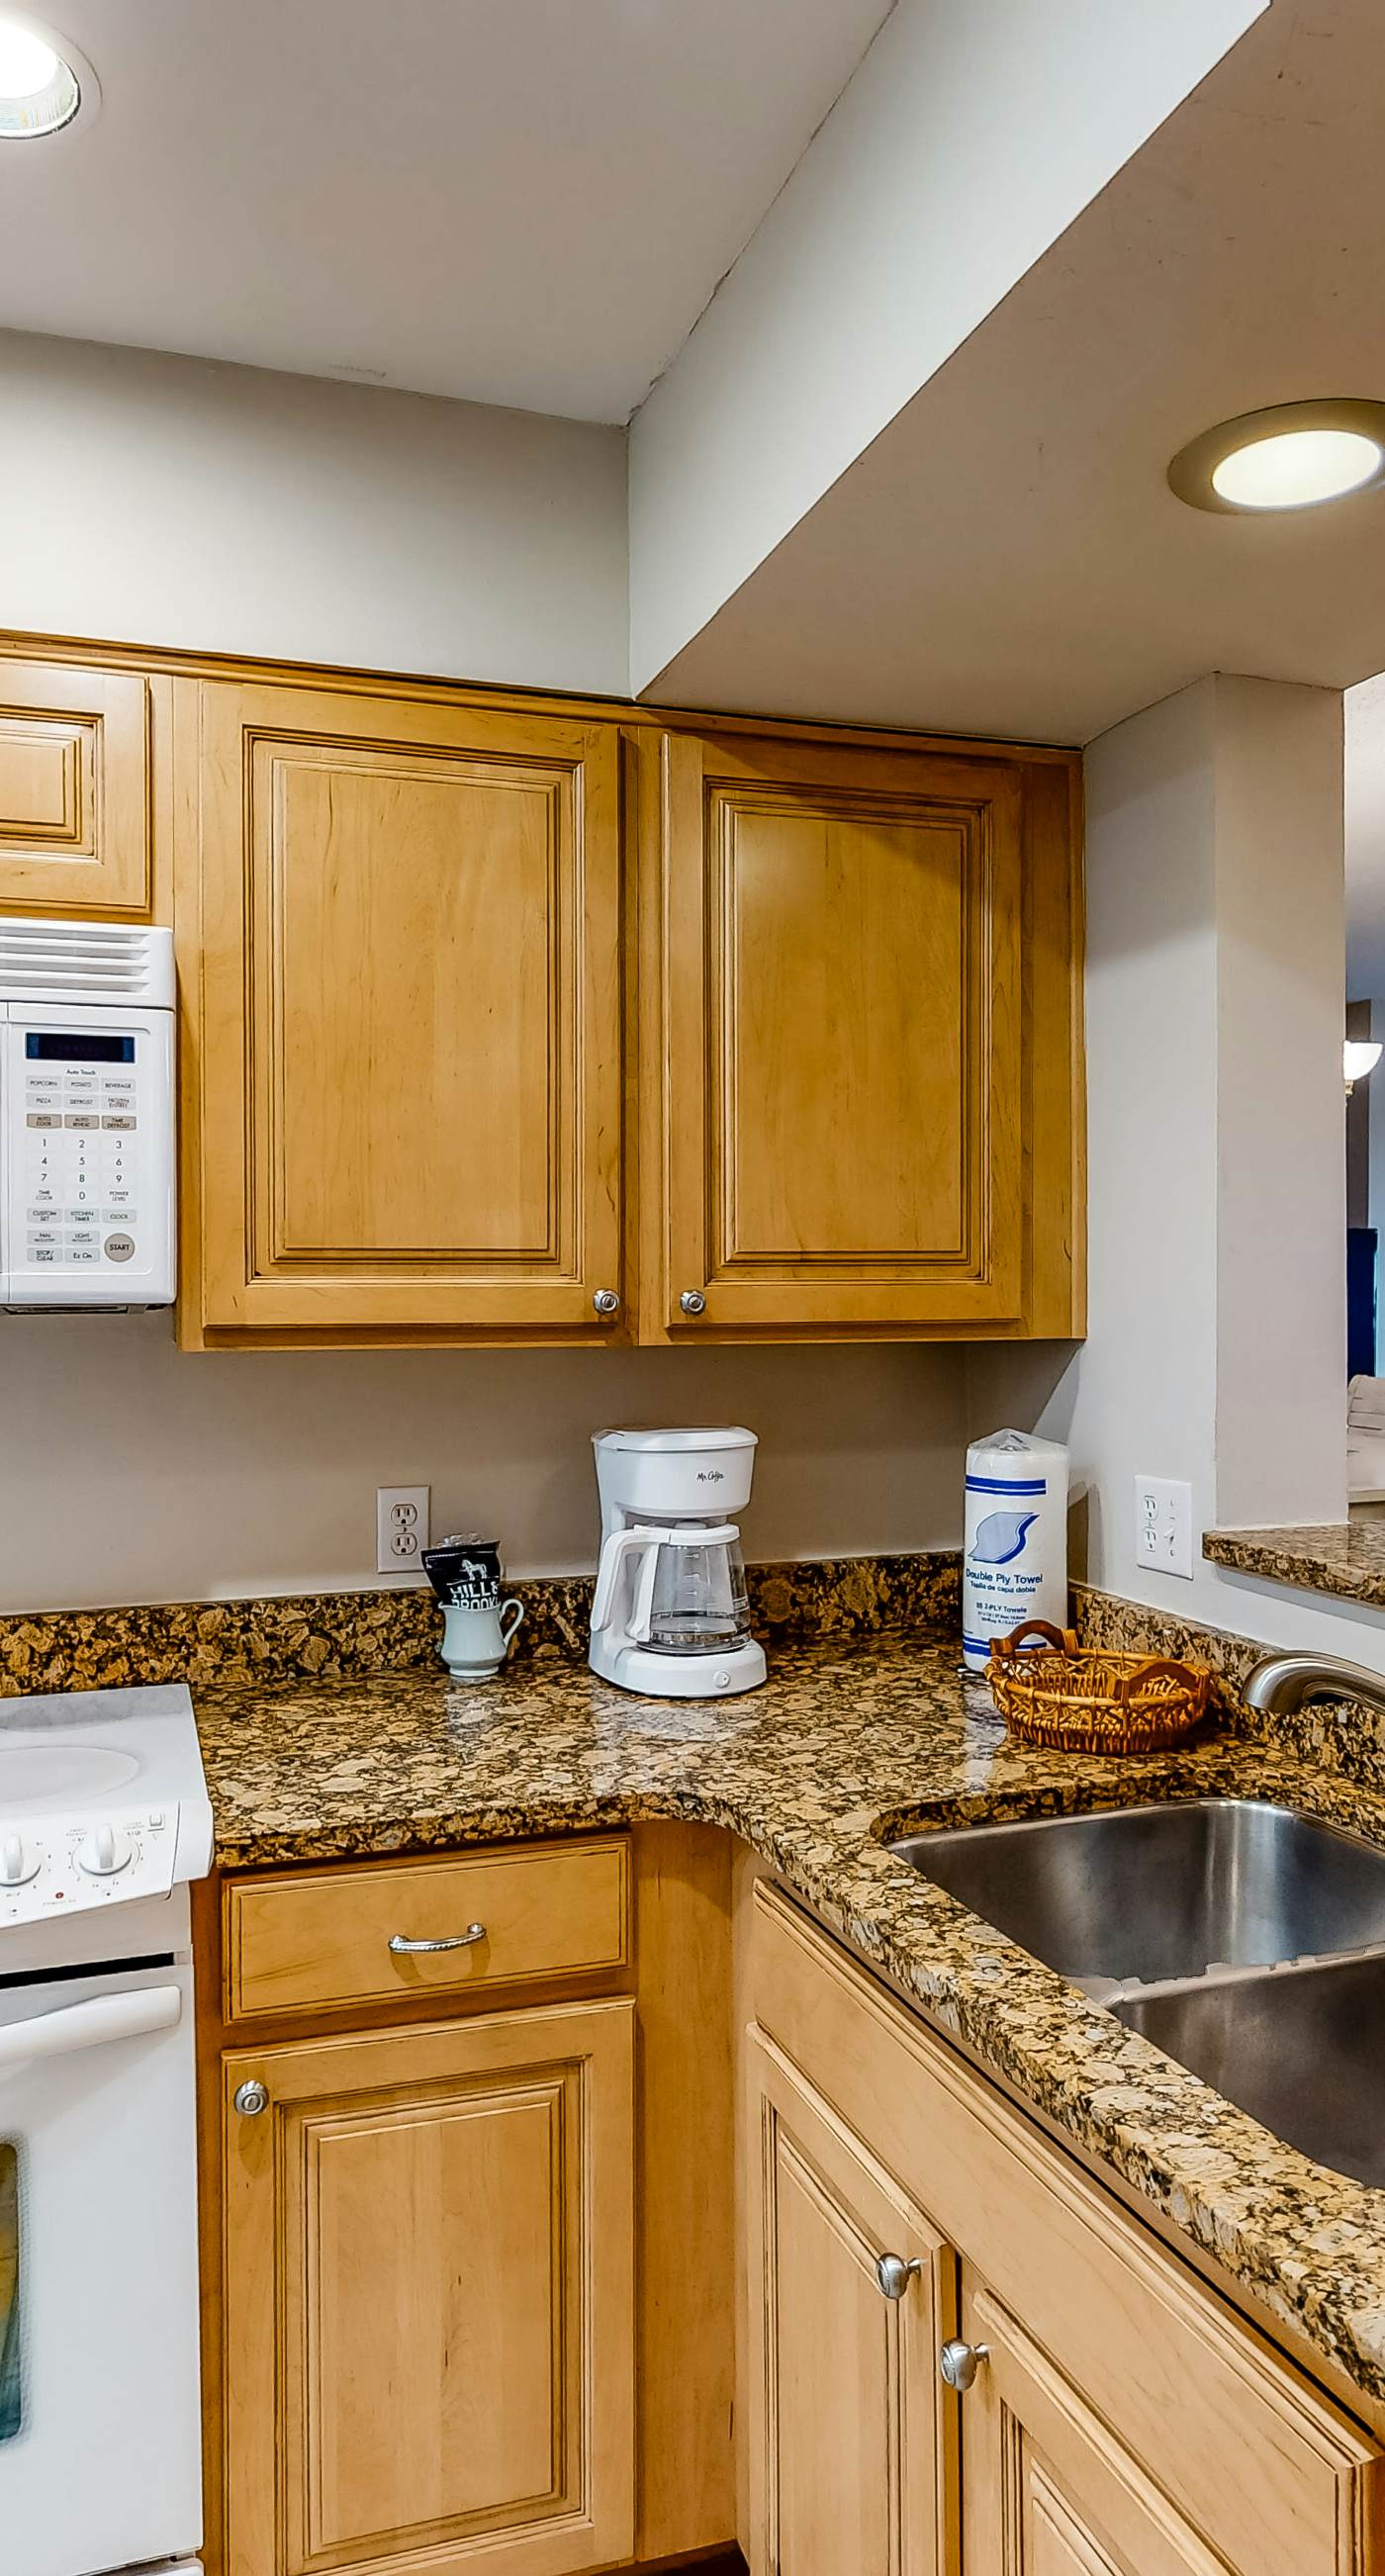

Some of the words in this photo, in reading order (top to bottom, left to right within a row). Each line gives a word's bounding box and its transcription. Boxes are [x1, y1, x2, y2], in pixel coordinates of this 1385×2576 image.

[43, 1139, 46, 1148] 1
[78, 1140, 85, 1149] 2
[116, 1141, 122, 1150] 3
[78, 1156, 85, 1165] 5
[116, 1174, 122, 1183] 9
[79, 1191, 85, 1200] 0
[966, 1568, 993, 1582] Double
[996, 1573, 1010, 1586] Ply
[1014, 1573, 1043, 1585] Towel
[449, 1581, 492, 1599] HILL
